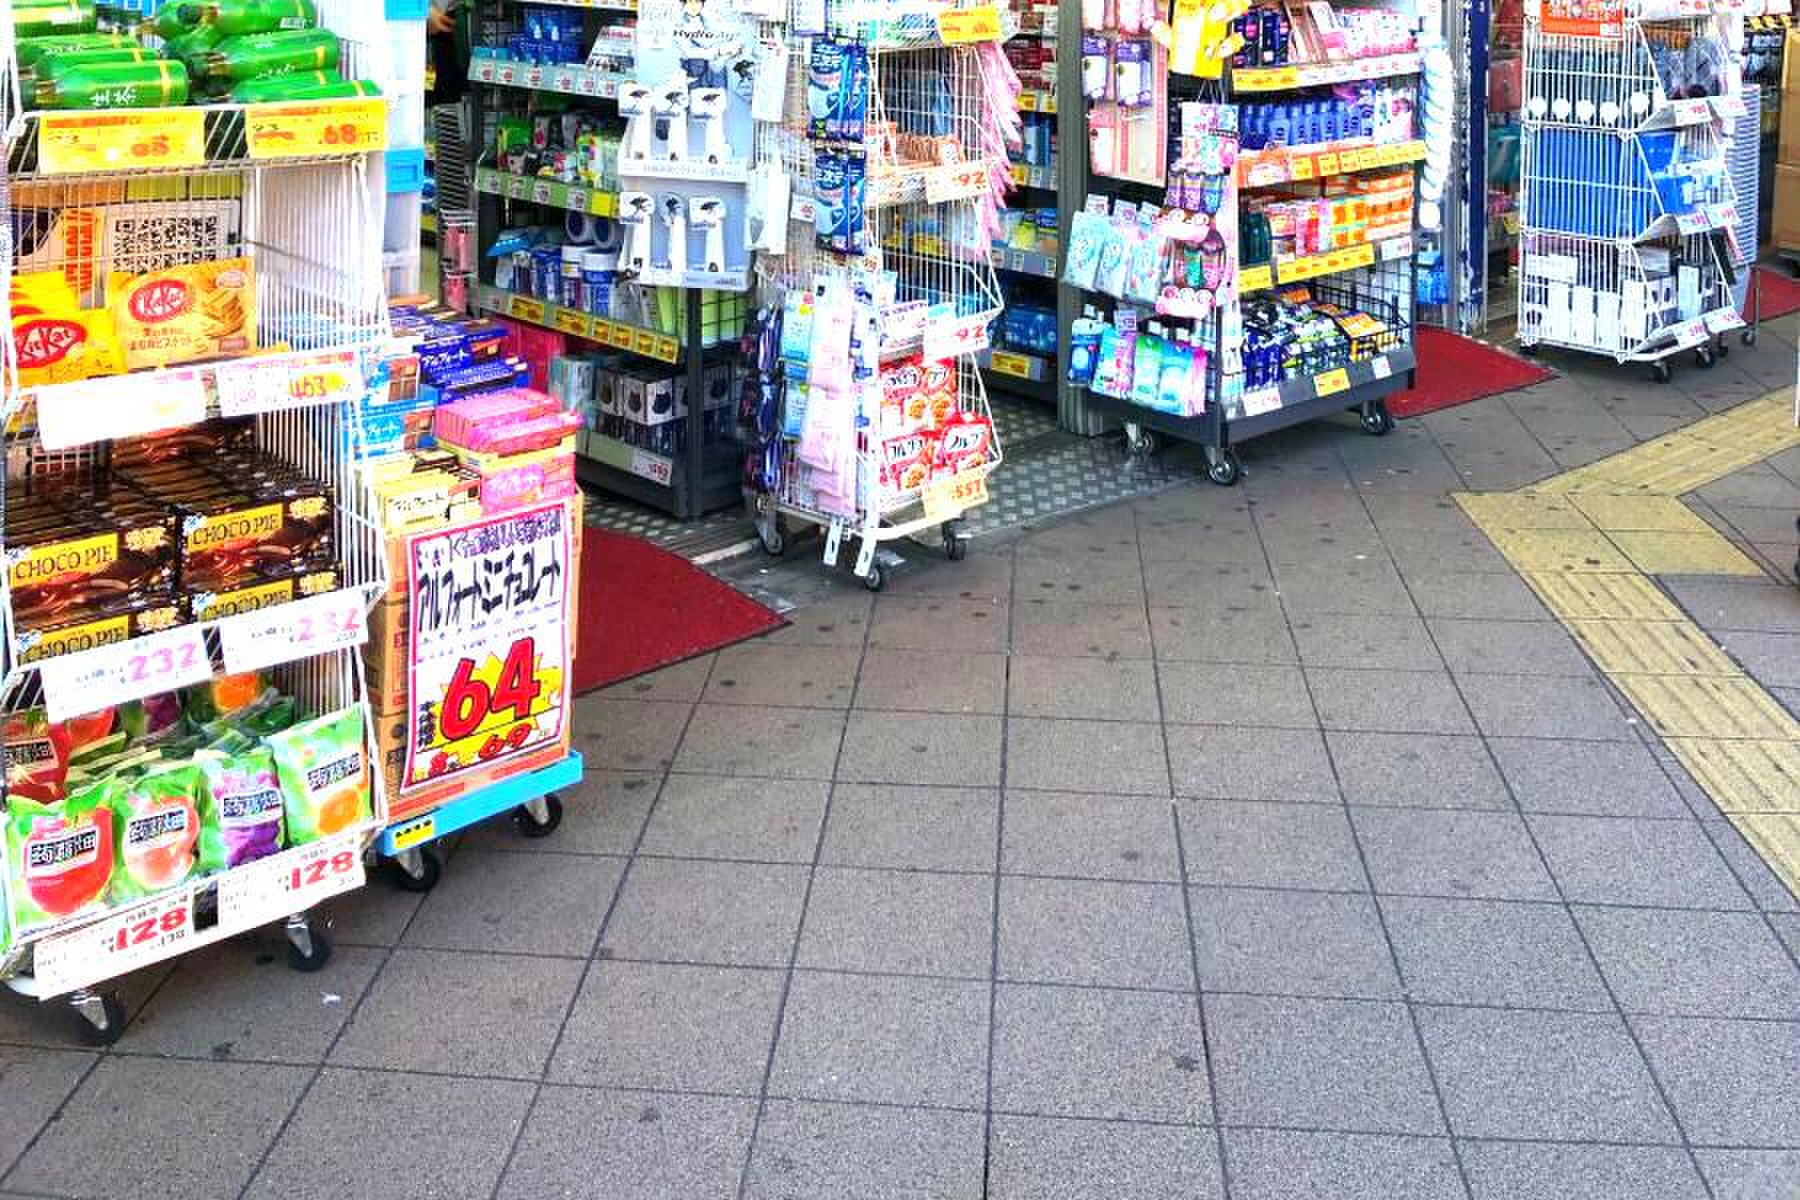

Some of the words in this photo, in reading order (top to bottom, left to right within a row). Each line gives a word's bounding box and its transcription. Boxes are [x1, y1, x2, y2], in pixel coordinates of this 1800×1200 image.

[192, 519, 251, 545] CHOCO
[253, 512, 280, 534] PIE
[15, 551, 82, 579] CHOCO
[84, 544, 114, 566] PIE
[440, 636, 542, 742] 64
[290, 850, 356, 891] 128
[115, 906, 189, 951] 128
